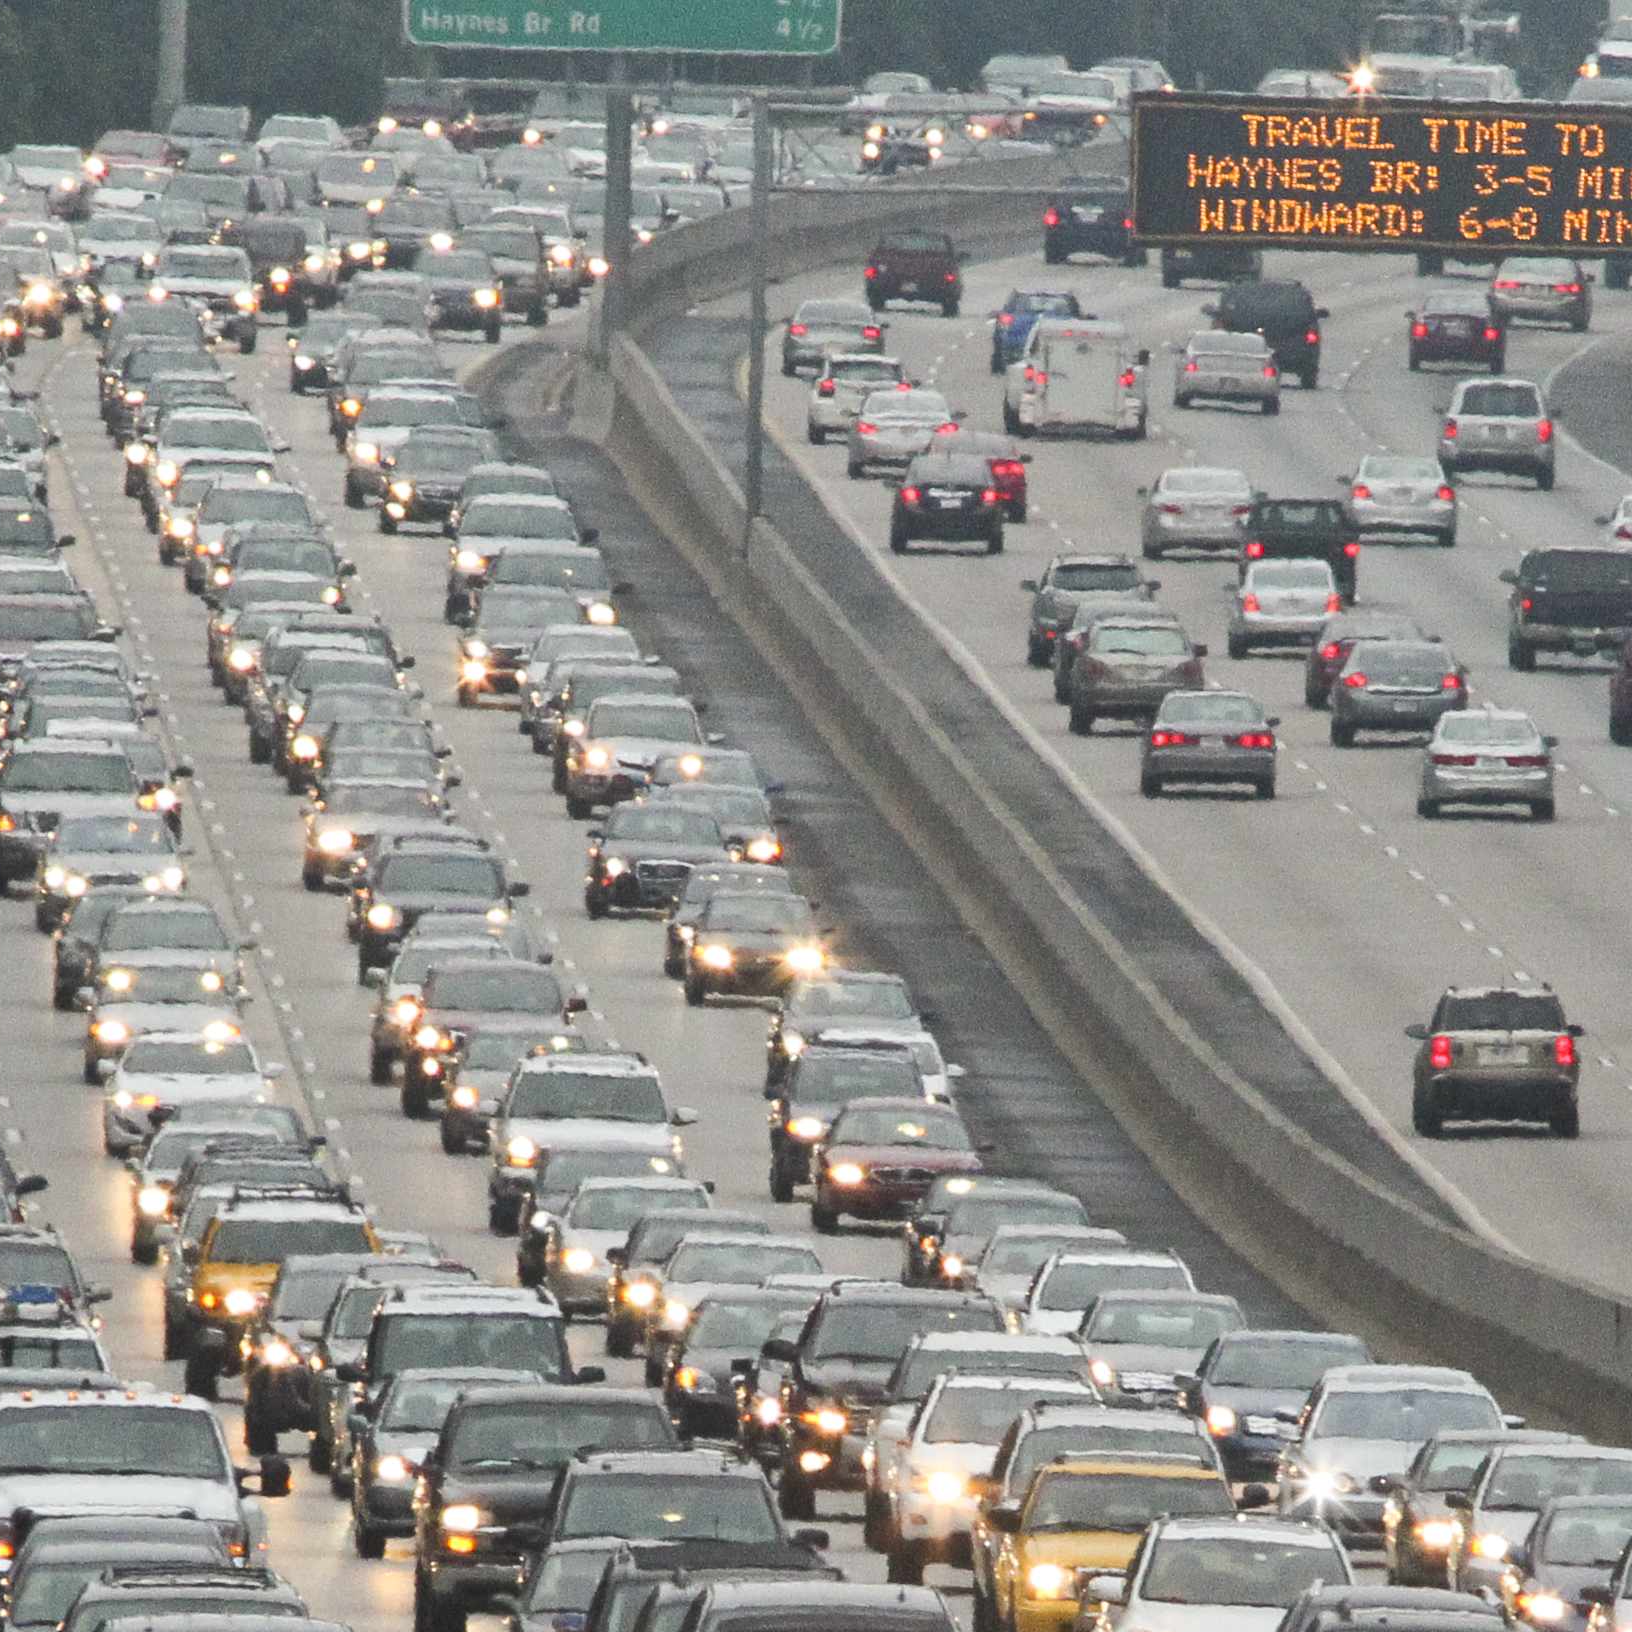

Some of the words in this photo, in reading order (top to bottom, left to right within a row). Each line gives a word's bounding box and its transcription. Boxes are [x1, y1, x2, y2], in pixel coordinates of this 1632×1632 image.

[421, 7, 509, 35] Haynes
[524, 11, 552, 35] Br
[569, 11, 601, 34] Rd
[776, 17, 791, 36] 4
[1242, 114, 1395, 150] TRAVEL
[1423, 118, 1527, 156] TIME
[1555, 122, 1605, 157] TO
[1187, 154, 1342, 192] HAYNES
[1369, 161, 1439, 193] BR:
[1473, 165, 1553, 197] 3-5
[1198, 199, 1426, 234] WINDWARD:
[1458, 206, 1539, 240] 6-8
